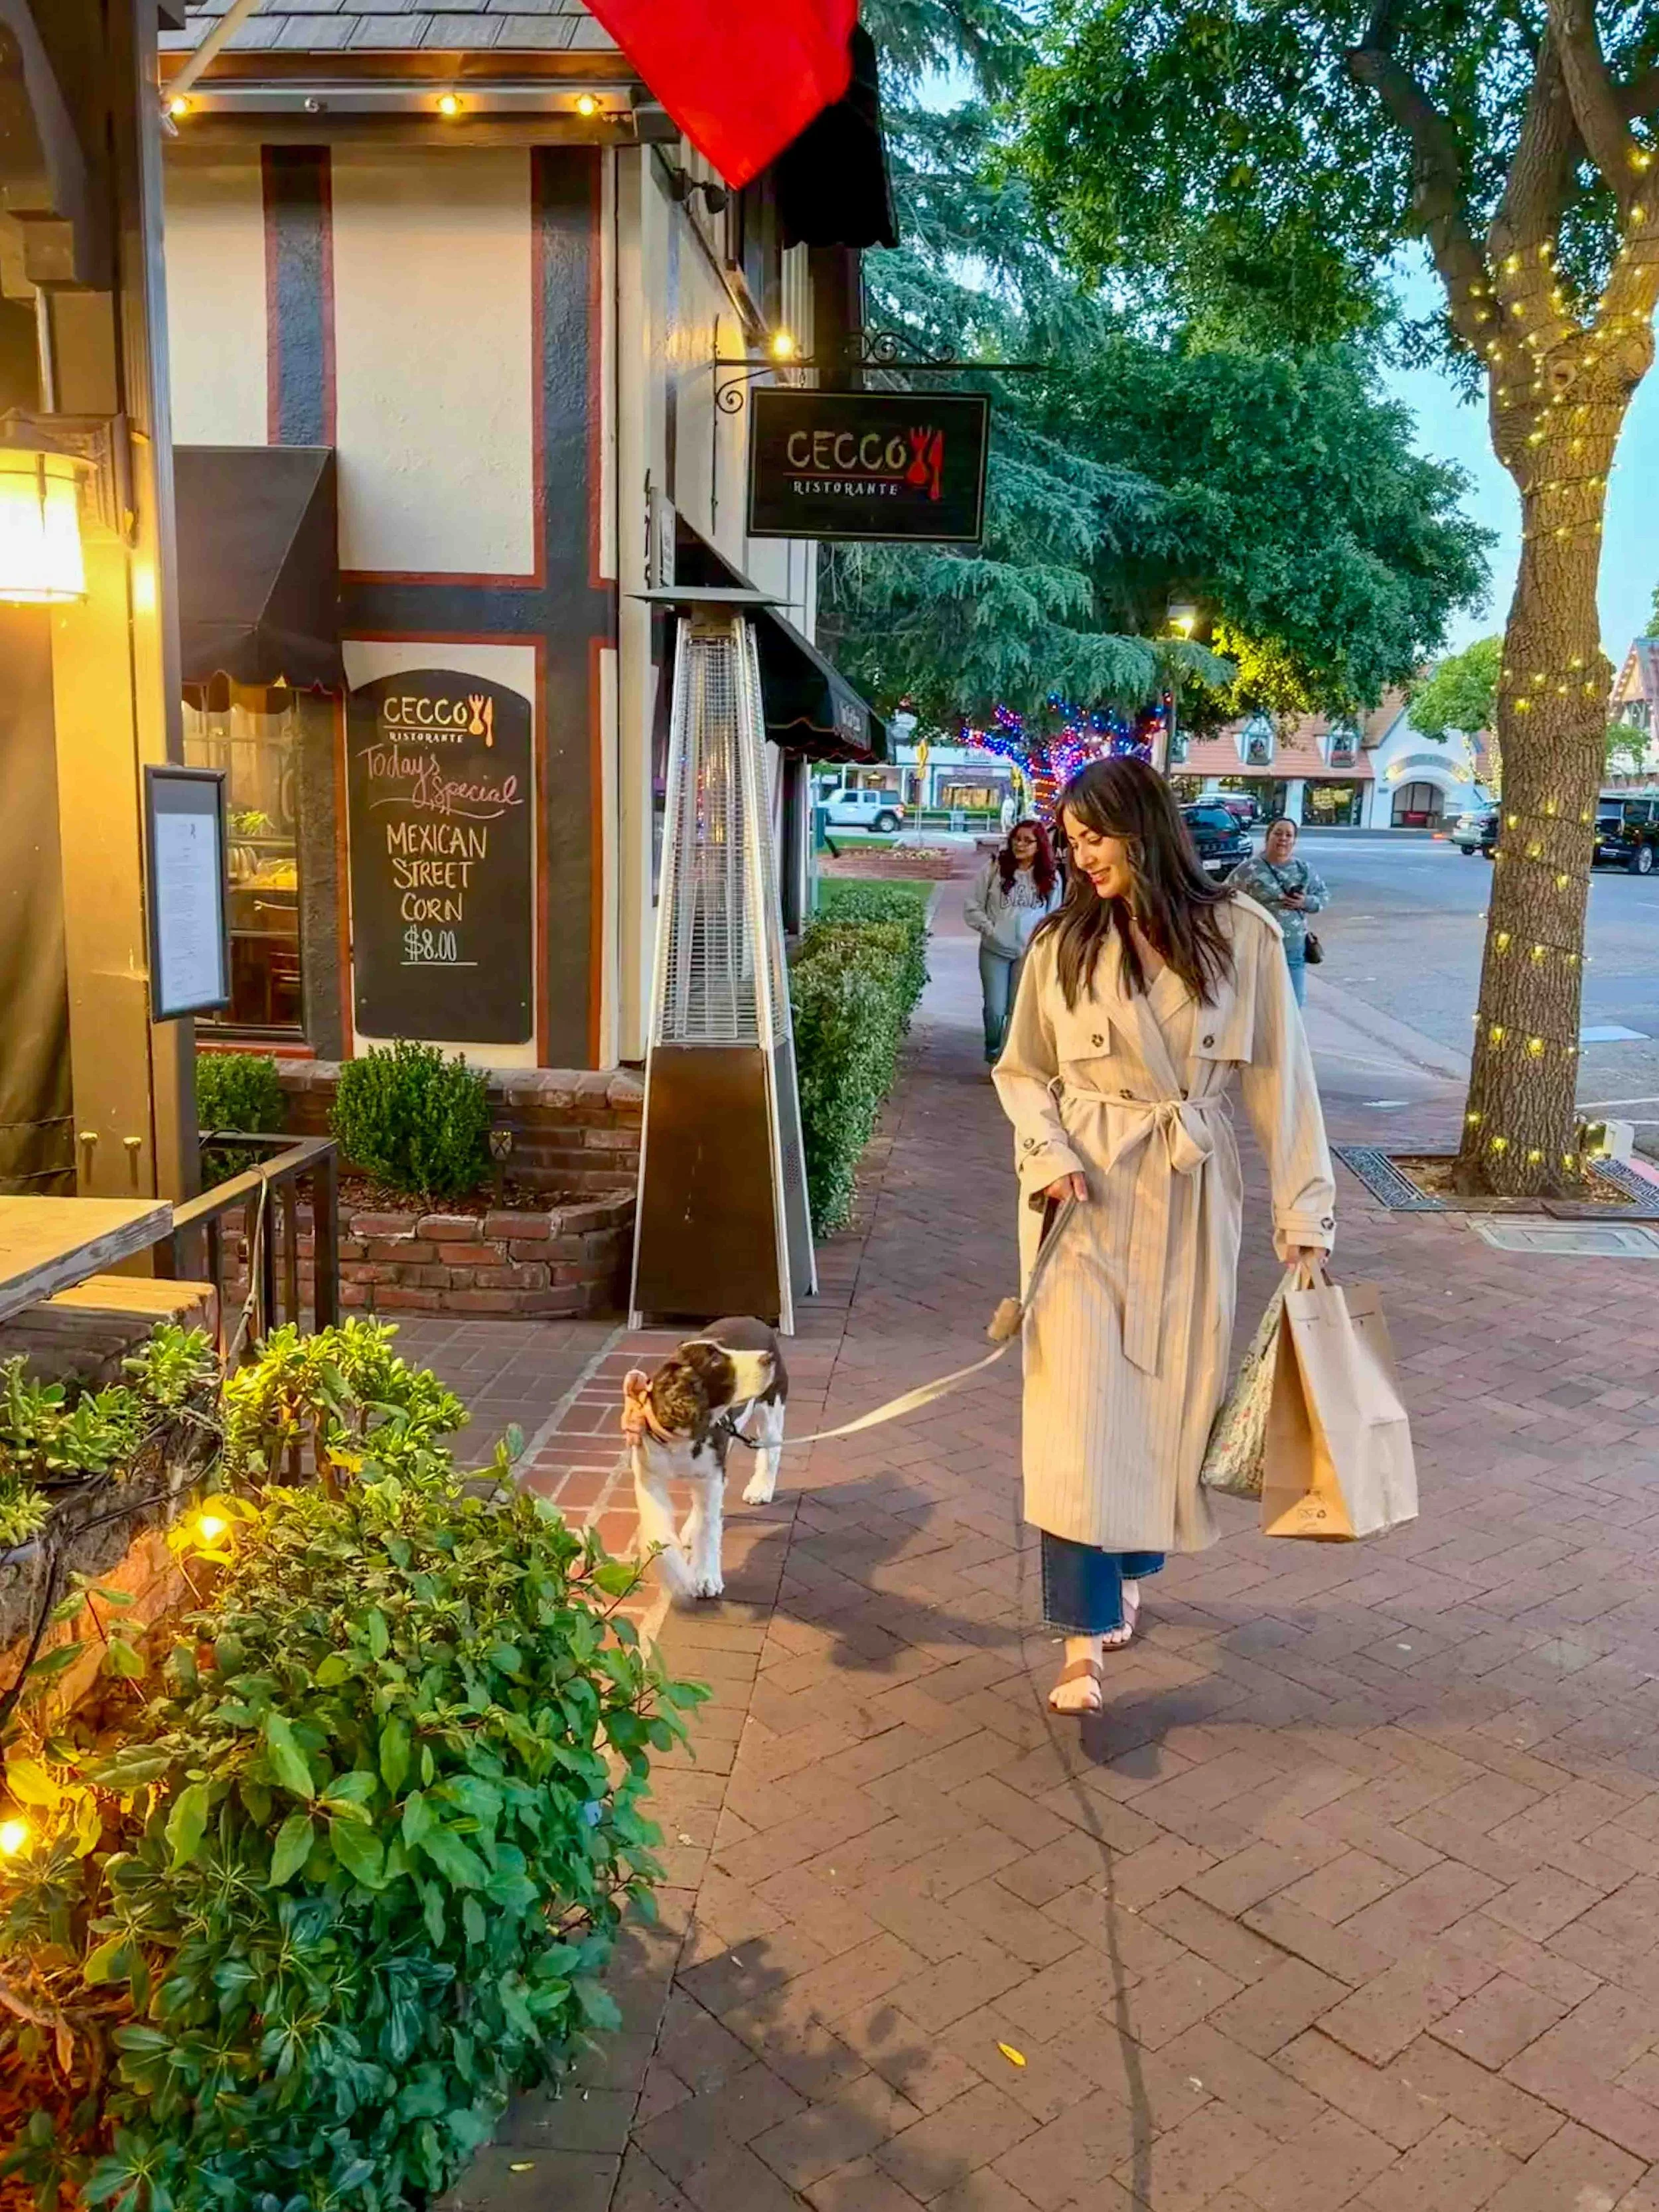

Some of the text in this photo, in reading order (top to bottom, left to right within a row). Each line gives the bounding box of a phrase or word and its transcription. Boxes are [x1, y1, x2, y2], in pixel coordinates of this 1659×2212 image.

[787, 431, 906, 470] CECCO
[793, 480, 899, 496] RISTORANTE
[384, 696, 467, 725] CECCO
[389, 731, 464, 743] RISTORANTE
[431, 774, 524, 814] Special
[386, 822, 487, 859] MEXICAN
[392, 857, 474, 889] STREET
[401, 892, 463, 922] CORN
[404, 924, 458, 962] $8.00
